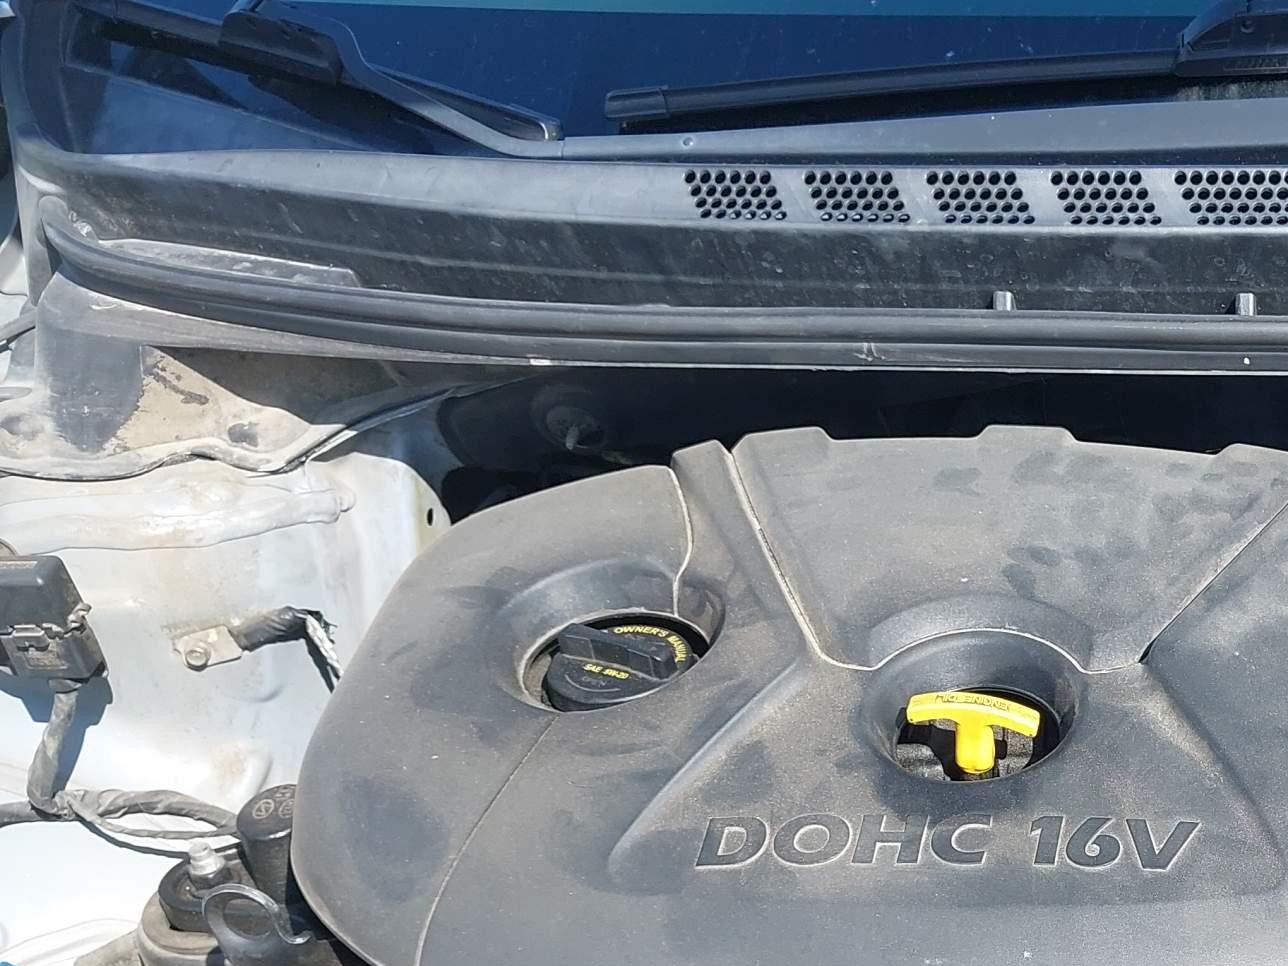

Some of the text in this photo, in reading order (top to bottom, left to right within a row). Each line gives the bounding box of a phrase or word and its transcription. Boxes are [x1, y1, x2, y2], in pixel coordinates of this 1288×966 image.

[613, 625, 688, 663] OWNER'S MANUAL
[583, 663, 604, 673] SAE
[695, 814, 1201, 871] DOHC 16V
